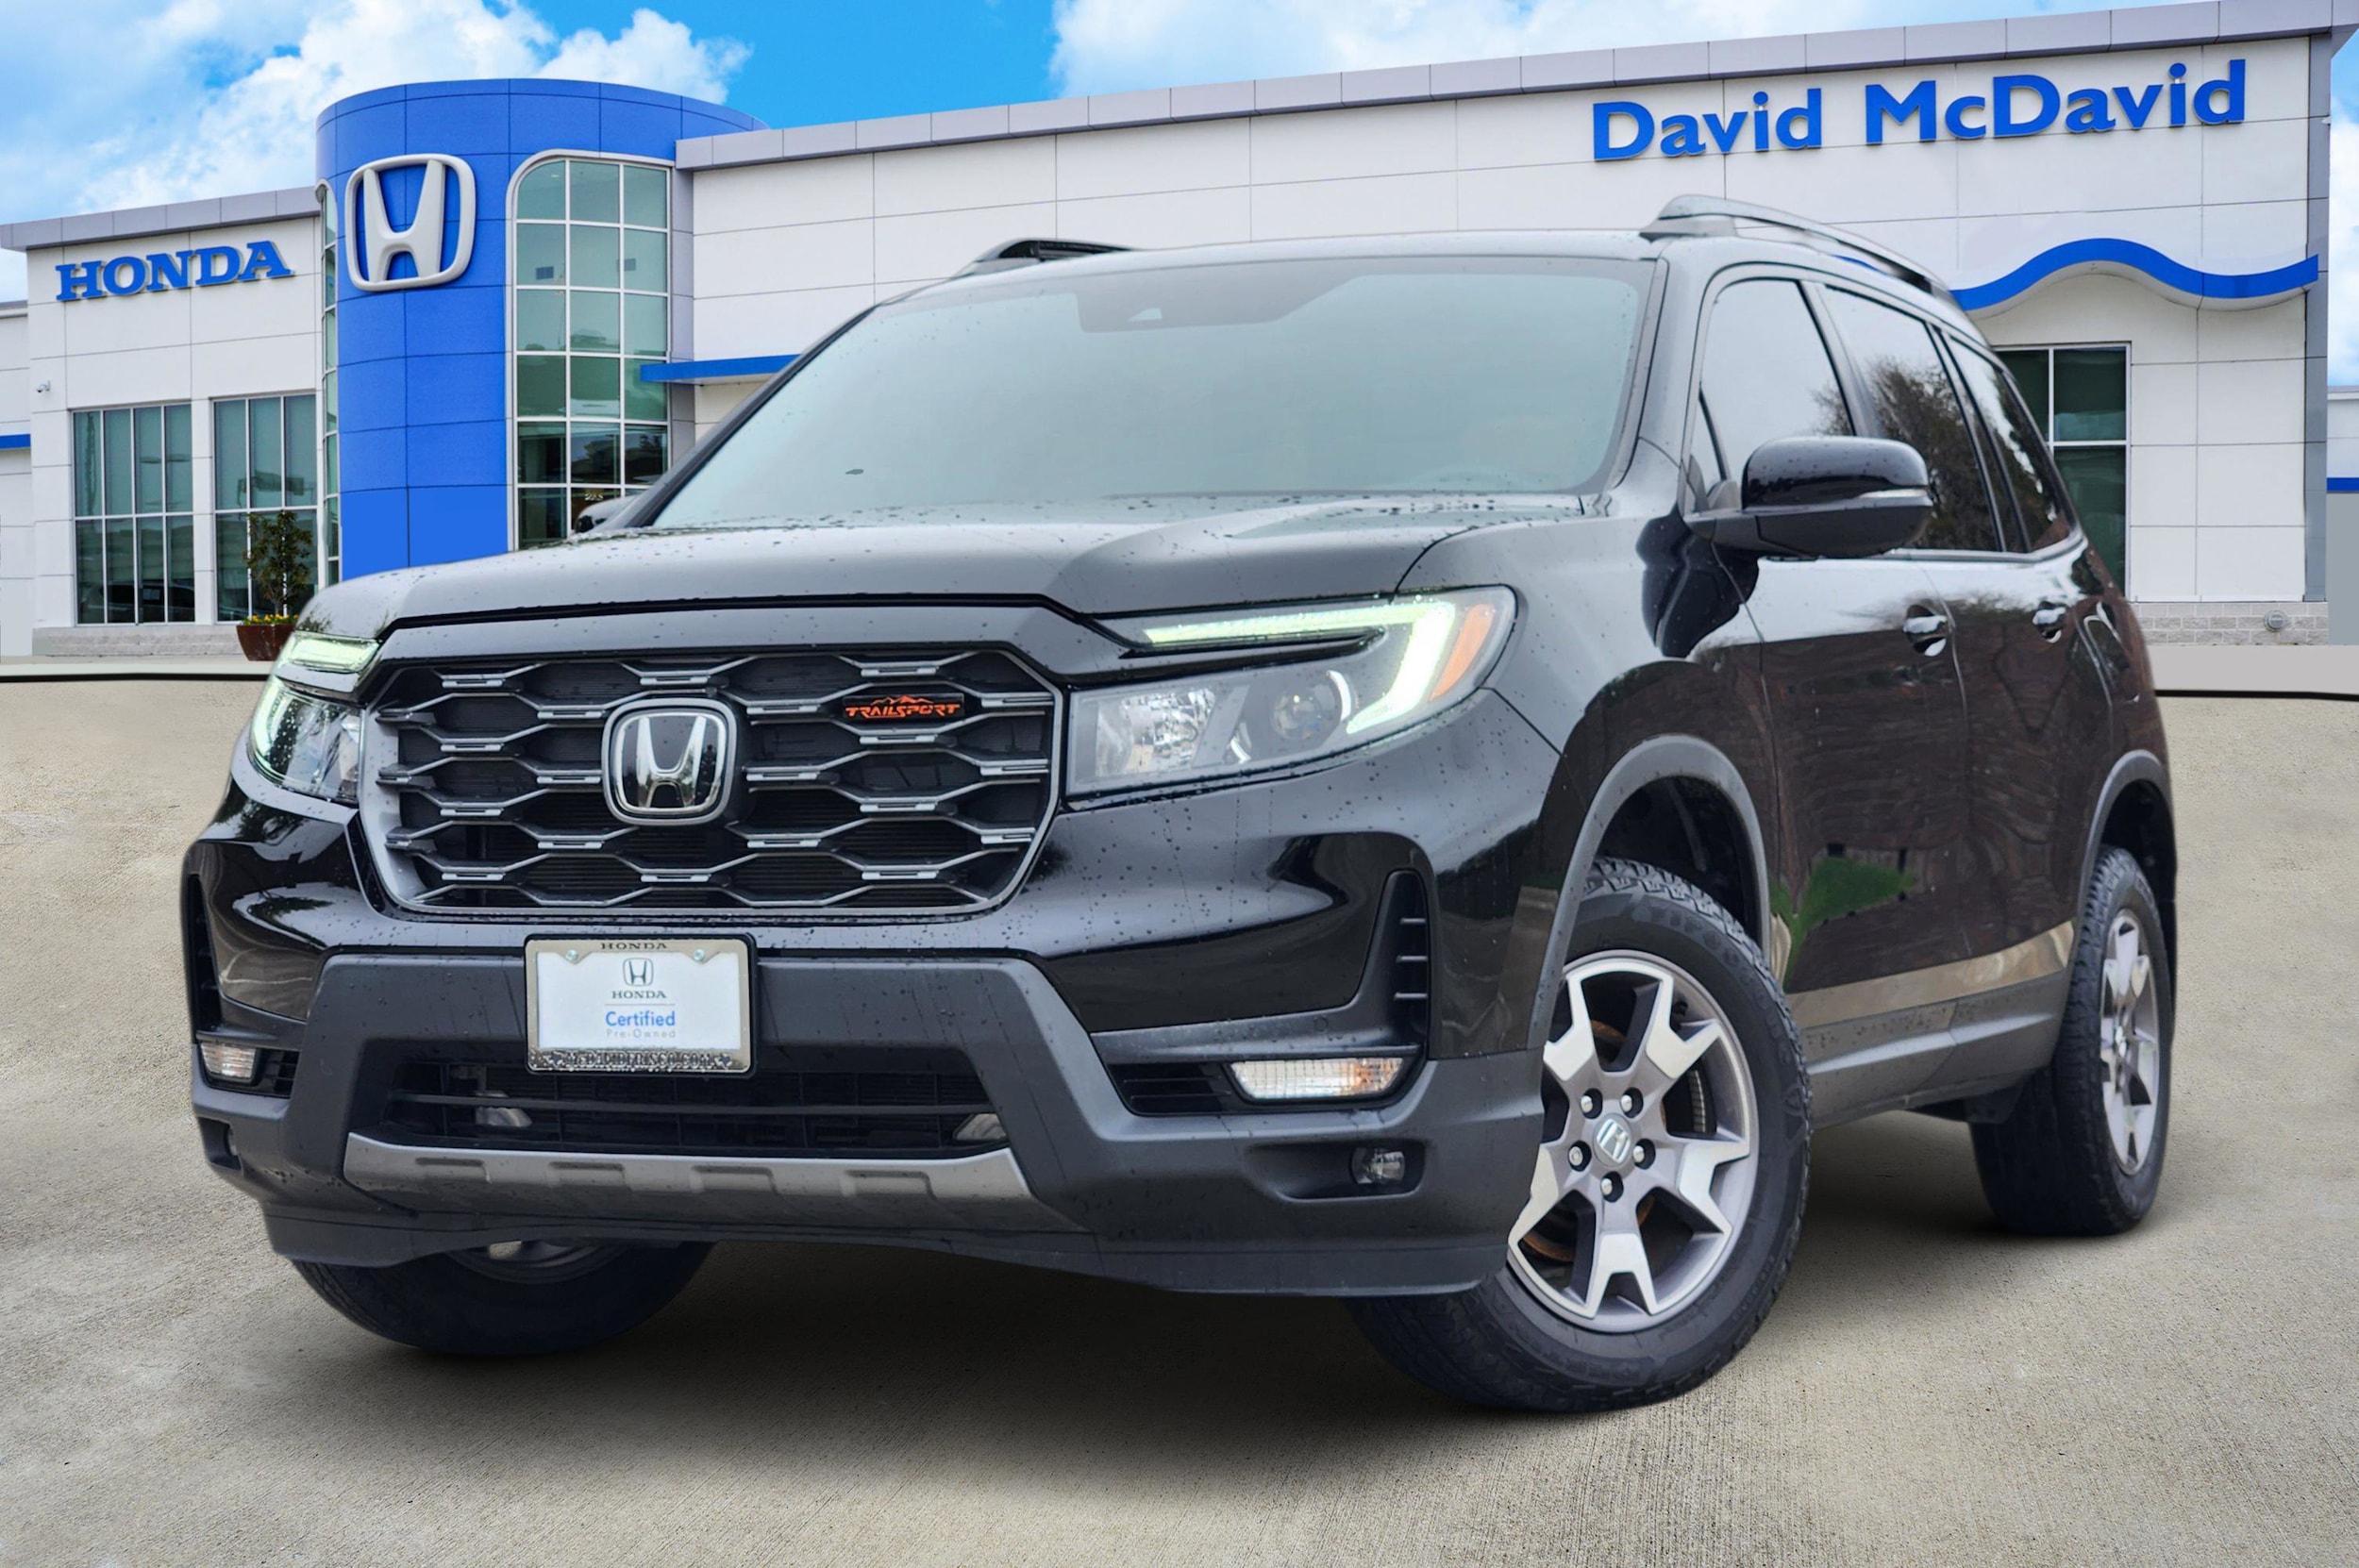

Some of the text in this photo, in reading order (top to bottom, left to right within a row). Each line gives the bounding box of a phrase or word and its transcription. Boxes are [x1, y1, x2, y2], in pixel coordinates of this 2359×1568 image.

[1594, 58, 2247, 162] David McDavid
[56, 240, 293, 302] HONDA
[845, 703, 961, 719] TRAILSPORT
[600, 942, 668, 950] HONDA
[611, 990, 667, 999] HONDA
[605, 1010, 676, 1027] Certified
[605, 1027, 677, 1039] Pre-Owned
